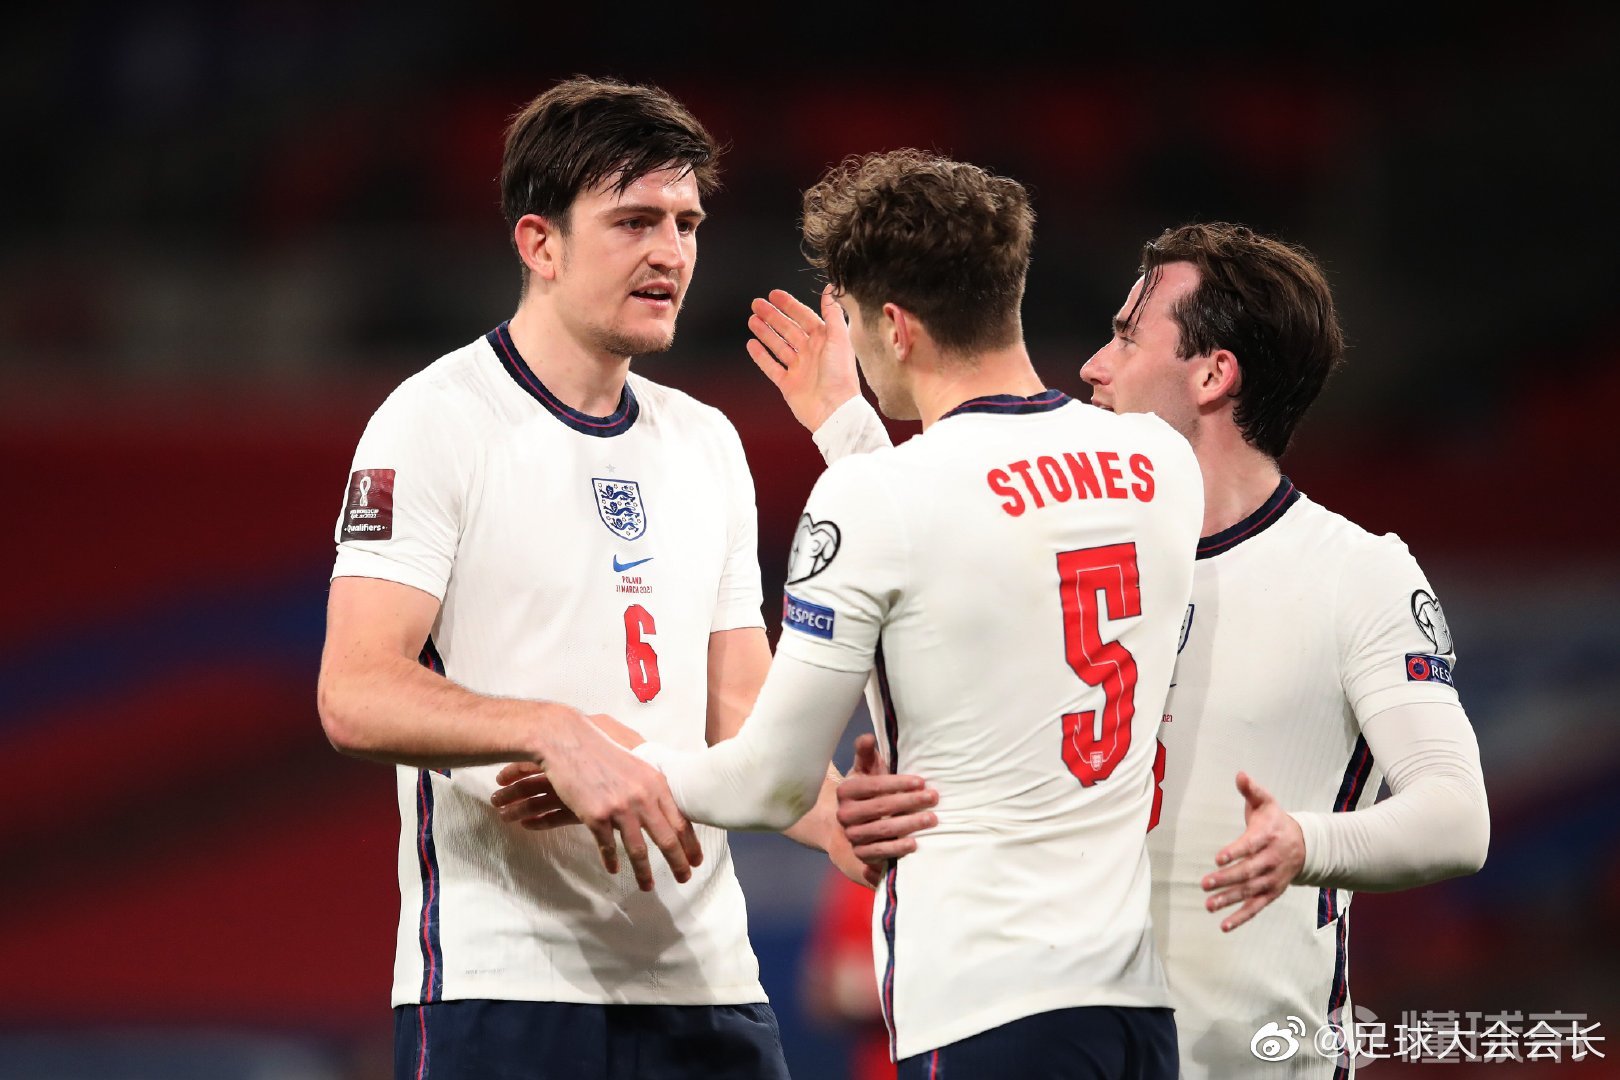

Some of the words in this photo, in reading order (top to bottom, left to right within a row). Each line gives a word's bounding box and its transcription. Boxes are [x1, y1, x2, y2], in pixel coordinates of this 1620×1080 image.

[986, 451, 1155, 517] STONES
[621, 575, 642, 584] POLAND
[624, 604, 661, 703] 6
[1056, 542, 1142, 788] 5
[1431, 664, 1451, 683] RES
[1161, 714, 1173, 722] 021
